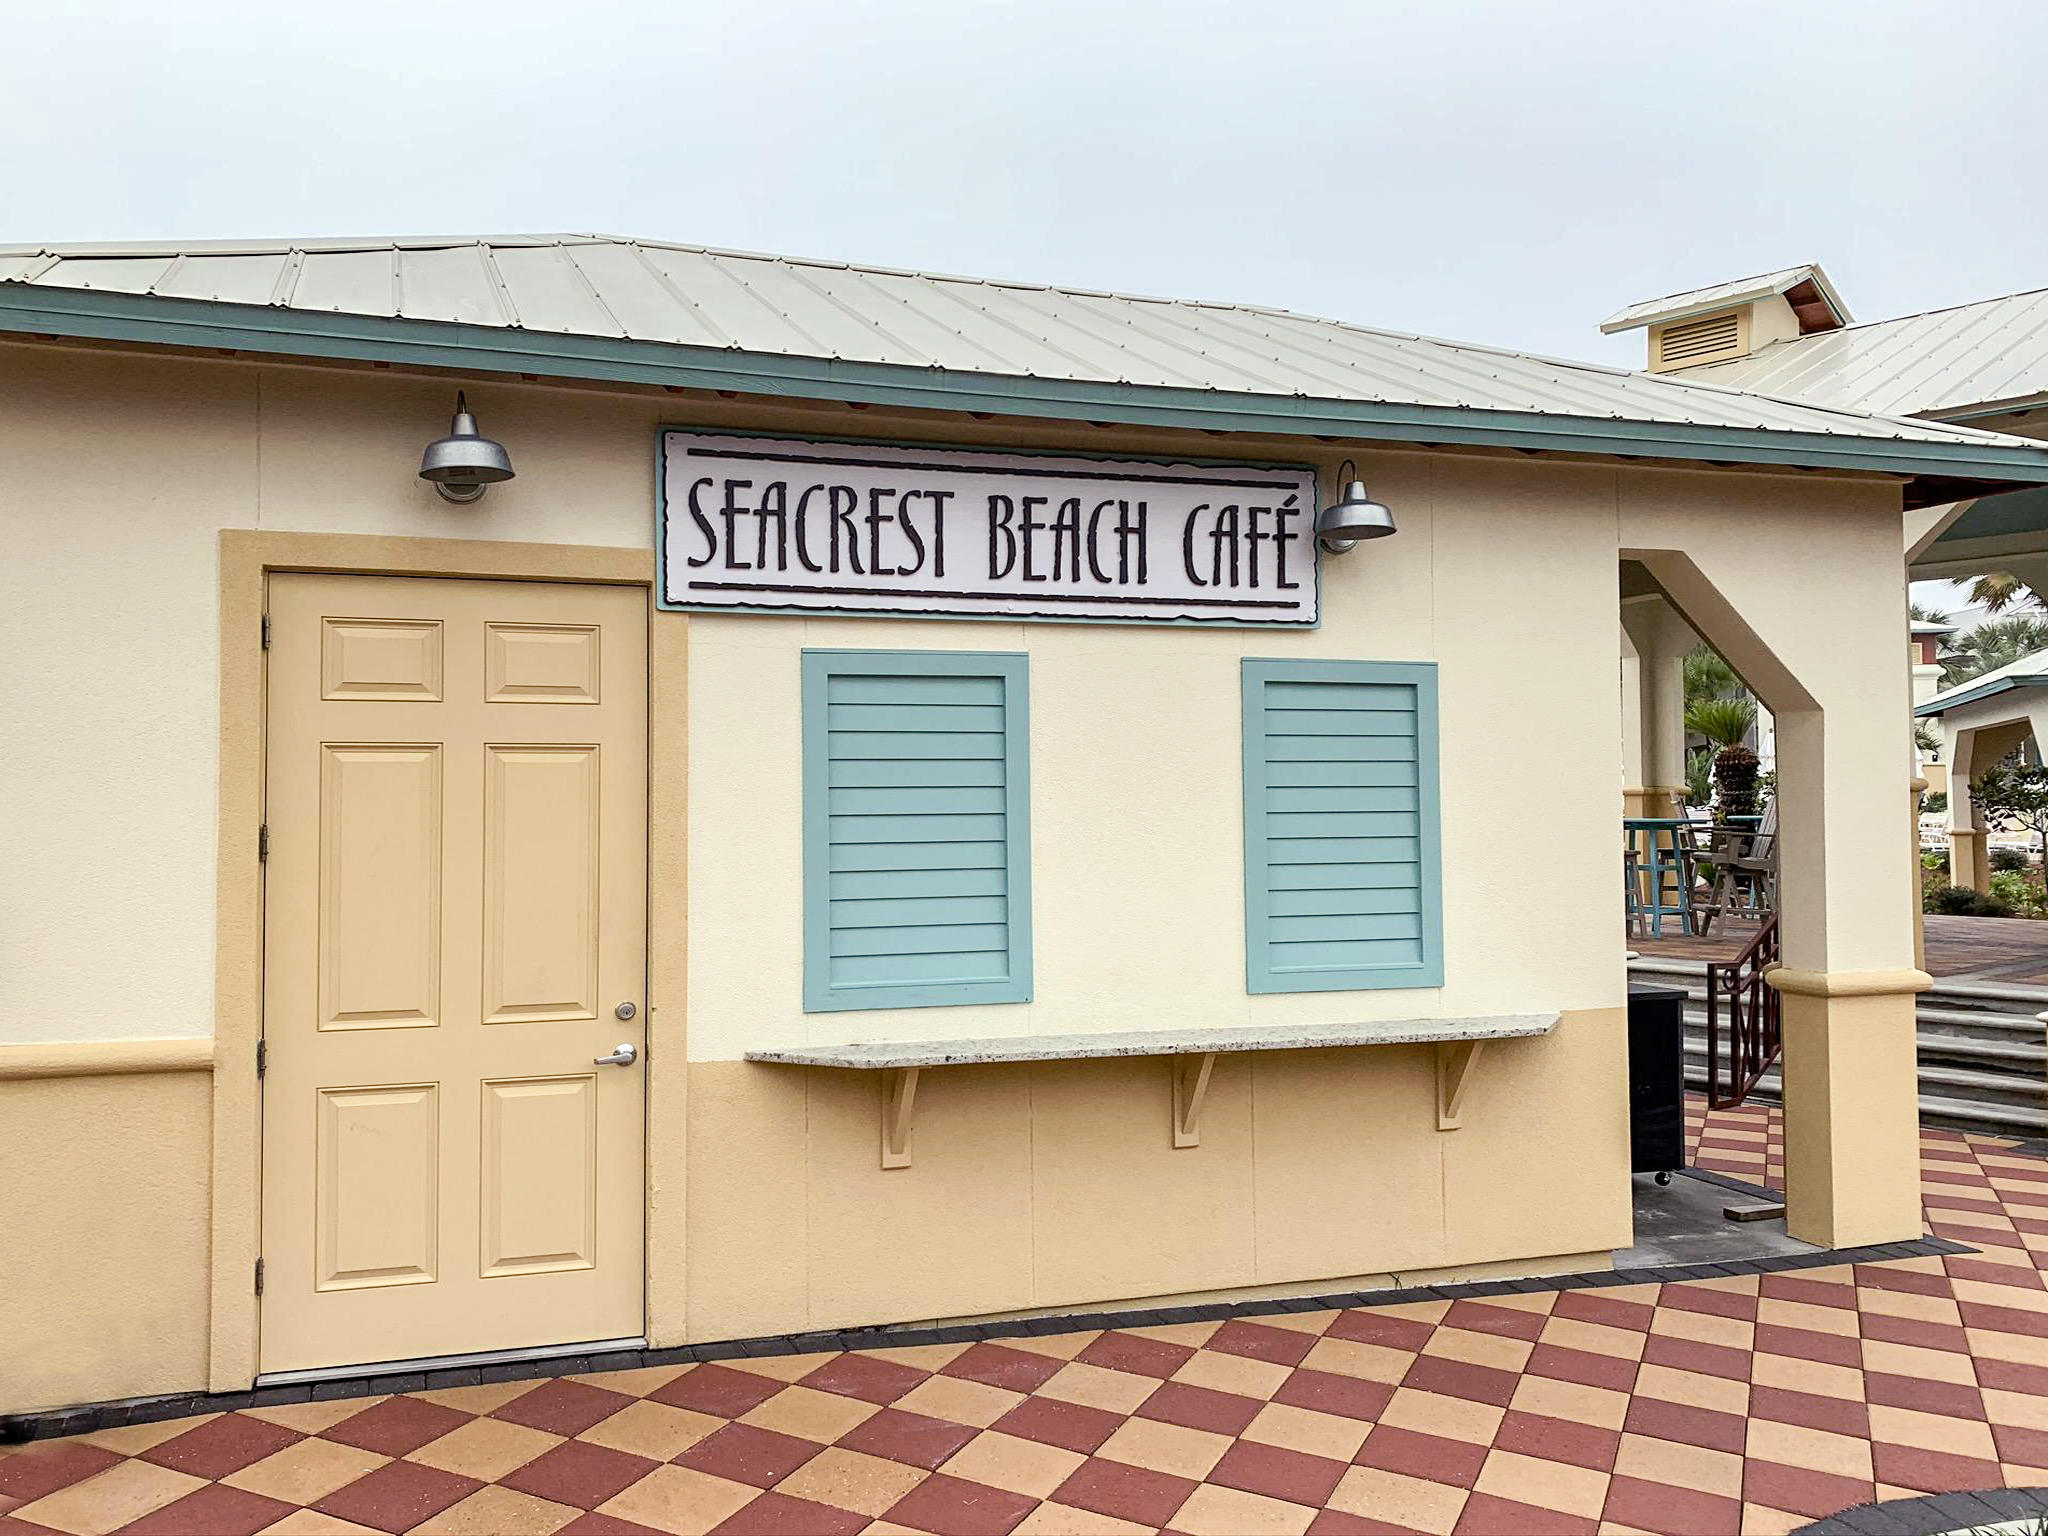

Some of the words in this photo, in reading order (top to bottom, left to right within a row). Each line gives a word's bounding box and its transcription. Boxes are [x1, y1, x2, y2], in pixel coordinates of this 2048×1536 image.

[688, 477, 954, 578] SEACREST
[988, 494, 1148, 584] BEACH
[1183, 494, 1300, 589] CAFÉ
